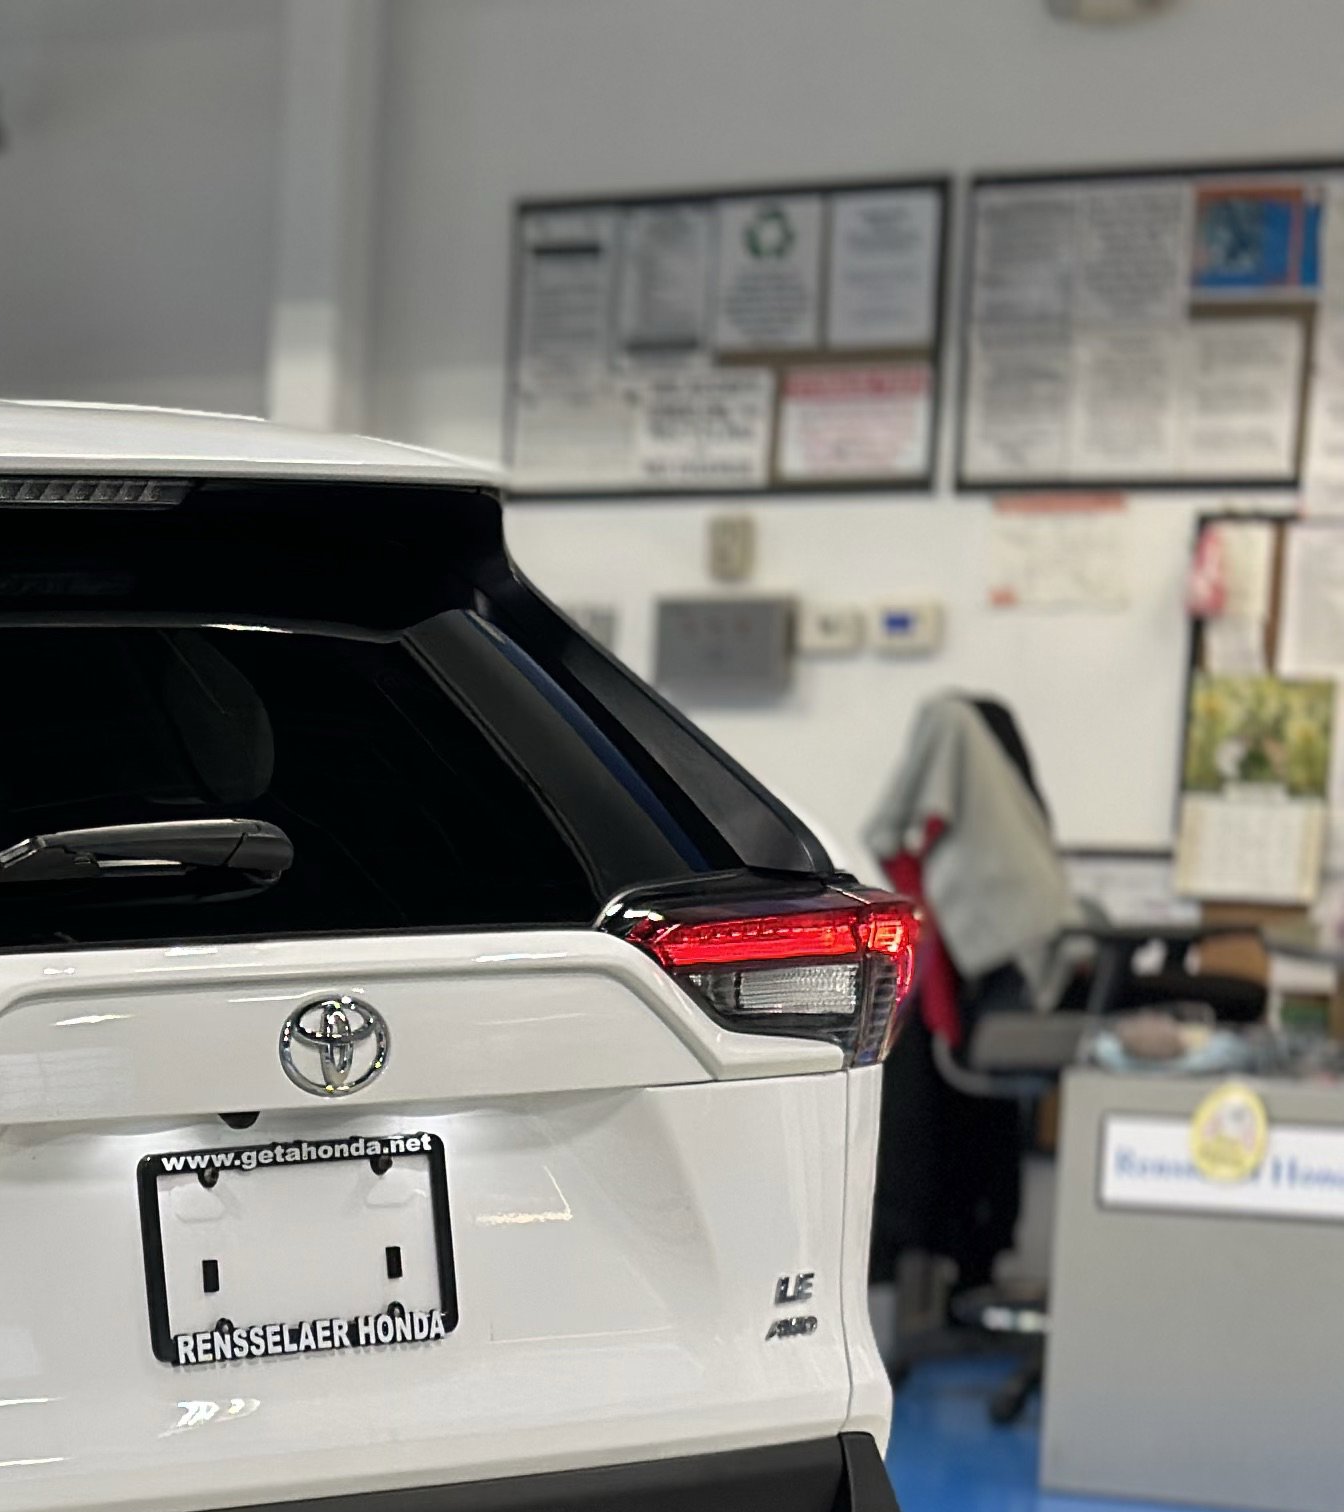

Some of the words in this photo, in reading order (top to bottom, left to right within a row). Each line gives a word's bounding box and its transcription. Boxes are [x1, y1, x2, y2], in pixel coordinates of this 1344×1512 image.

[161, 1132, 433, 1172] www.getahonda.net
[774, 1272, 815, 1305] LE
[177, 1318, 350, 1364] RENSSELAER
[358, 1309, 446, 1345] HONDA
